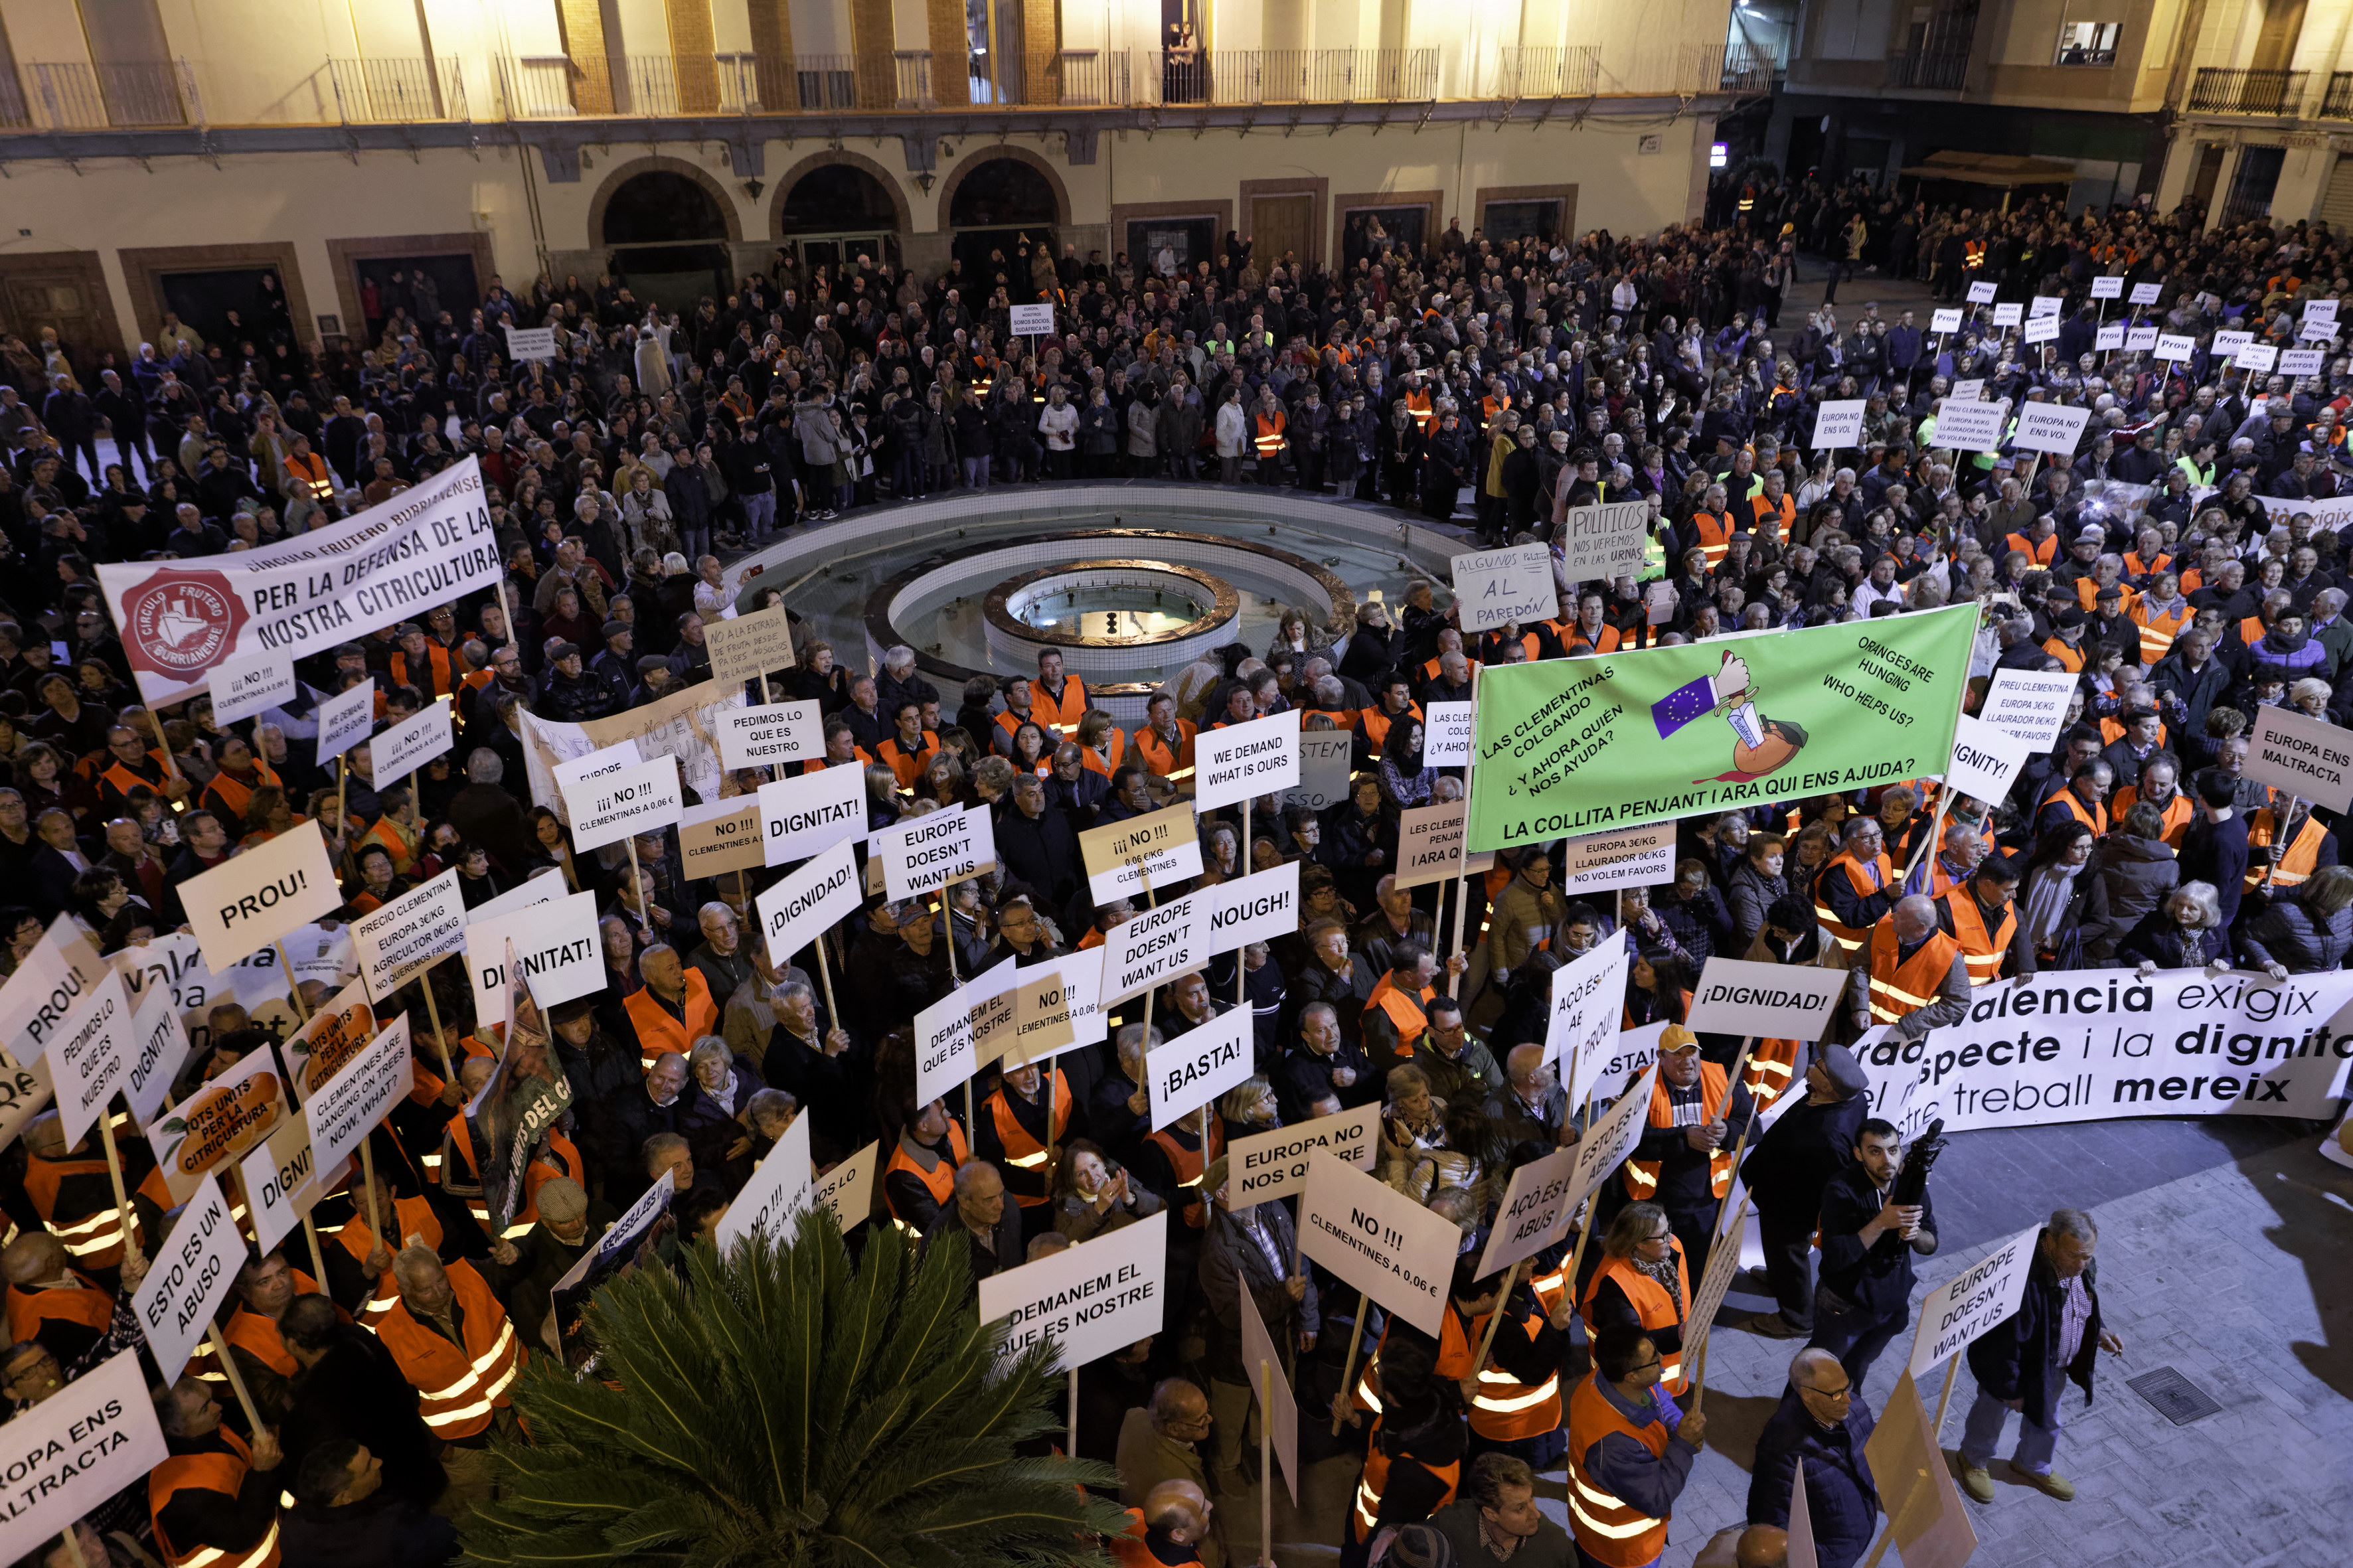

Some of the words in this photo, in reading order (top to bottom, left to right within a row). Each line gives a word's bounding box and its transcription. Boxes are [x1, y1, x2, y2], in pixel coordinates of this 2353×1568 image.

[2161, 341, 2188, 349] Prou
[1962, 407, 1999, 416] CLEMENTINA
[2028, 415, 2064, 427] EUROPA
[2029, 428, 2048, 437] ENS
[2050, 431, 2066, 439] VOL
[319, 522, 388, 556] FRUTERO
[391, 476, 481, 526] BURRIANENSE
[255, 582, 298, 614] PER
[309, 572, 333, 599] LA
[343, 530, 429, 586] DEFENSA
[431, 516, 462, 547] DE
[468, 507, 490, 536] LA
[1458, 554, 1516, 574] ALGUNOS
[1574, 539, 1591, 553] NOS
[1594, 534, 1635, 550] VEREMOS
[1574, 556, 1587, 566] EN
[1591, 554, 1605, 565] LAS
[1611, 548, 1643, 562] URNAS
[179, 586, 223, 617] FRUTERO
[258, 600, 353, 650] NOSTRA
[357, 544, 500, 616] CITRICULTURA
[1477, 595, 1548, 624] PAREDÓN
[1483, 579, 1517, 599] AL
[153, 626, 223, 665] BURRIANENSE
[710, 631, 724, 645] NO
[747, 618, 781, 634] ENTRADA
[714, 647, 724, 657] DE
[727, 641, 750, 652] FRUTA
[754, 633, 778, 645] DESDE
[1858, 637, 1912, 671] ORANGES
[1909, 663, 1934, 683] ARE
[1858, 658, 1910, 692] HUNGING
[734, 712, 784, 728] PEDIMOS
[787, 712, 802, 721] LO
[1482, 735, 1512, 759] LAS
[1514, 666, 1615, 737] CLEMENTINAS
[1823, 674, 1854, 697] WHO
[1856, 690, 1889, 715] HELPS
[1889, 706, 1913, 728] US?
[750, 730, 773, 741] QUE
[776, 728, 791, 738] ES
[1513, 696, 1591, 758] COLGANDO
[1518, 775, 1528, 785] Y
[1532, 739, 1580, 779] AHORA
[1581, 704, 1623, 740] QUIÉN
[1735, 718, 1753, 744] Sudáfrica
[746, 742, 799, 757] NUESTRO
[1214, 751, 1232, 765] WE
[1235, 737, 1283, 759] DEMAND
[1528, 772, 1561, 797] NOS
[1564, 730, 1614, 777] AYUDA?
[2261, 750, 2342, 785] MALTRACTA
[2265, 731, 2320, 757] EUROPA
[2322, 749, 2350, 767] ENS
[1208, 768, 1242, 786] WHAT
[1244, 764, 1254, 775] IS
[1257, 755, 1287, 773] OURS
[580, 806, 641, 832] CLEMENTINAS
[651, 798, 667, 811] 0,06
[614, 787, 635, 805] NO
[1504, 821, 1528, 839] LA
[1534, 807, 1612, 834] COLLITA
[1619, 789, 1709, 819] PENJANT
[1721, 783, 1759, 803] ARA
[1765, 777, 1797, 795] QUI
[1803, 770, 1838, 789] ENS
[1843, 759, 1915, 783] AJUDA?
[770, 799, 860, 838] DIGNITAT!
[1117, 858, 1177, 883] CLEMENTINES
[1125, 854, 1142, 866] 0,06
[1143, 848, 1163, 860] €/KG
[219, 870, 308, 929] PROU!
[359, 911, 394, 937] PRECIO
[396, 879, 451, 917] CLEMENTINA
[372, 932, 432, 975] AGRICULTOR
[434, 917, 459, 941] 0€/KG
[378, 922, 418, 951] EUROPA
[419, 905, 445, 929] 3€/KG
[376, 979, 388, 991] NO
[389, 951, 430, 983] QUEREMOS
[431, 932, 464, 957] FAVORES
[1702, 986, 1827, 1012] ¡DIGNIDAD!
[2177, 979, 2320, 1022] exigix
[923, 1052, 948, 1073] QUE
[950, 1037, 965, 1056] ÉS
[967, 1009, 1012, 1045] NOSTRE
[930, 1005, 987, 1048] DEMANEM
[990, 997, 1004, 1012] EL
[2083, 1028, 2091, 1058] i
[2113, 1028, 2154, 1058] la
[129, 1011, 174, 1093] DIGNITY!
[1163, 1037, 1241, 1103] ¡BASTA!
[317, 1052, 382, 1116] CLEMENTINES
[384, 1033, 401, 1052] ARE
[317, 1090, 361, 1137] HANGING
[362, 1078, 376, 1094] ON
[377, 1048, 405, 1081] TREES
[1954, 1074, 2092, 1115] treball
[2113, 1073, 2291, 1103] mereix
[184, 1109, 214, 1136] TOTS
[216, 1078, 251, 1109] UNITS
[202, 1118, 224, 1140] PER
[225, 1107, 243, 1122] LA
[329, 1115, 360, 1148] NOW,
[361, 1075, 398, 1117] WHAT?
[185, 1102, 268, 1170] CITRICULTURA
[1350, 1207, 1378, 1236] NO
[147, 1265, 184, 1329] ESTO
[184, 1235, 203, 1266] ES
[204, 1201, 222, 1233] UN
[1310, 1212, 1390, 1269] CLEMENTINES
[1402, 1269, 1427, 1293] 0,06
[1949, 1245, 2017, 1301] EUROPE
[176, 1253, 220, 1335] ABUSO
[1940, 1275, 2010, 1332] DOESN'T
[1933, 1324, 1979, 1360] WANT
[1982, 1302, 2004, 1327] US
